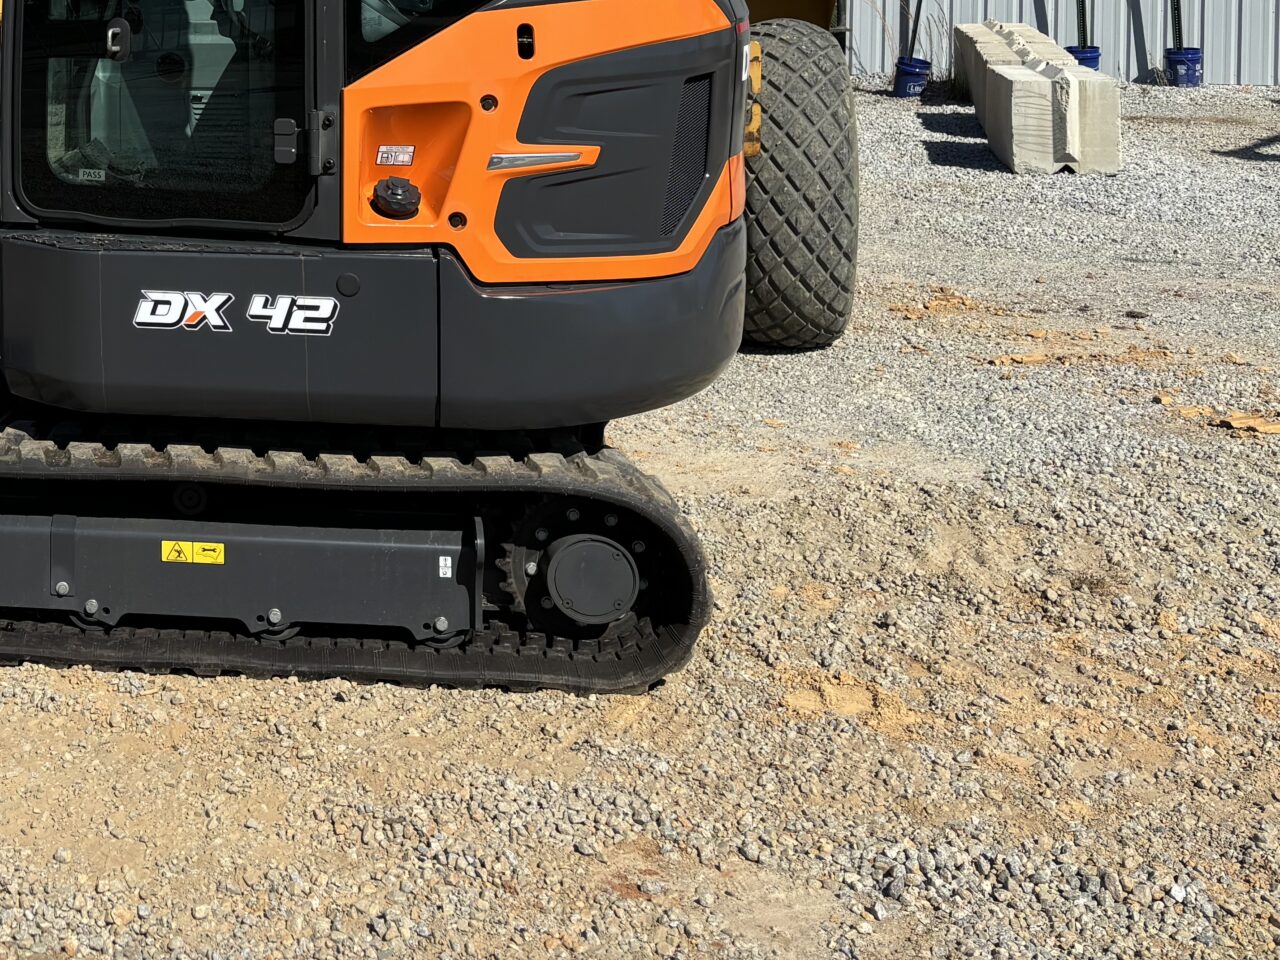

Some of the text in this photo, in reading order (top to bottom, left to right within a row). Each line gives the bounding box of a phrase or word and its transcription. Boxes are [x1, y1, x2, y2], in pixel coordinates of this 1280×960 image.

[82, 170, 102, 179] PASS
[133, 290, 341, 336] DX 42
